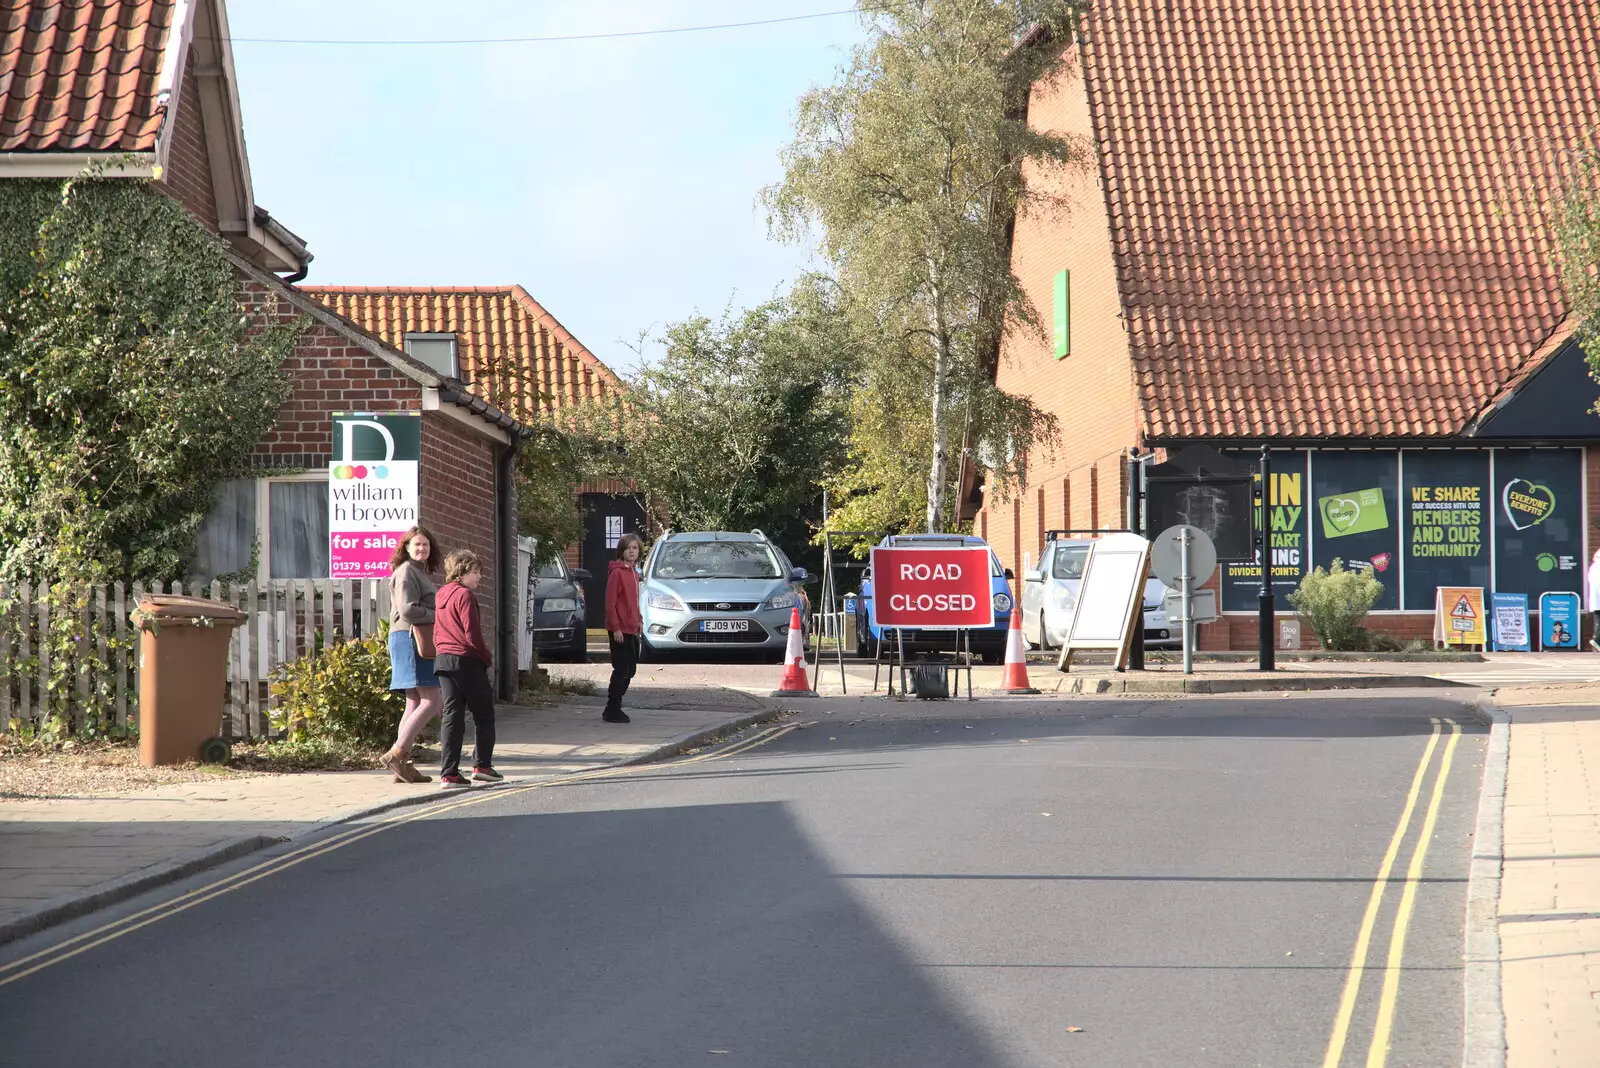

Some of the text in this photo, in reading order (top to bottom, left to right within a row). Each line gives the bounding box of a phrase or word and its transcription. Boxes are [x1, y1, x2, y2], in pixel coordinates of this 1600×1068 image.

[336, 420, 395, 461] D
[333, 483, 402, 501] william
[1411, 487, 1481, 502] WE SHARE
[1509, 491, 1549, 510] EVERYONE
[1510, 500, 1543, 516] BENEFITS
[335, 503, 414, 521] h brown
[1412, 510, 1481, 525] MEMBERS
[333, 535, 397, 549] for sale
[1270, 533, 1301, 547] TART
[1412, 526, 1480, 543] AND OUR
[1412, 544, 1481, 557] COMMUNITY
[333, 561, 392, 571] 01379 6447
[900, 564, 962, 581] ROAD
[1228, 567, 1300, 576] DIVIDEN POINTS
[889, 594, 976, 611] CLOSED
[706, 621, 747, 630] EJ09 VNS
[1283, 626, 1296, 634] Dog
